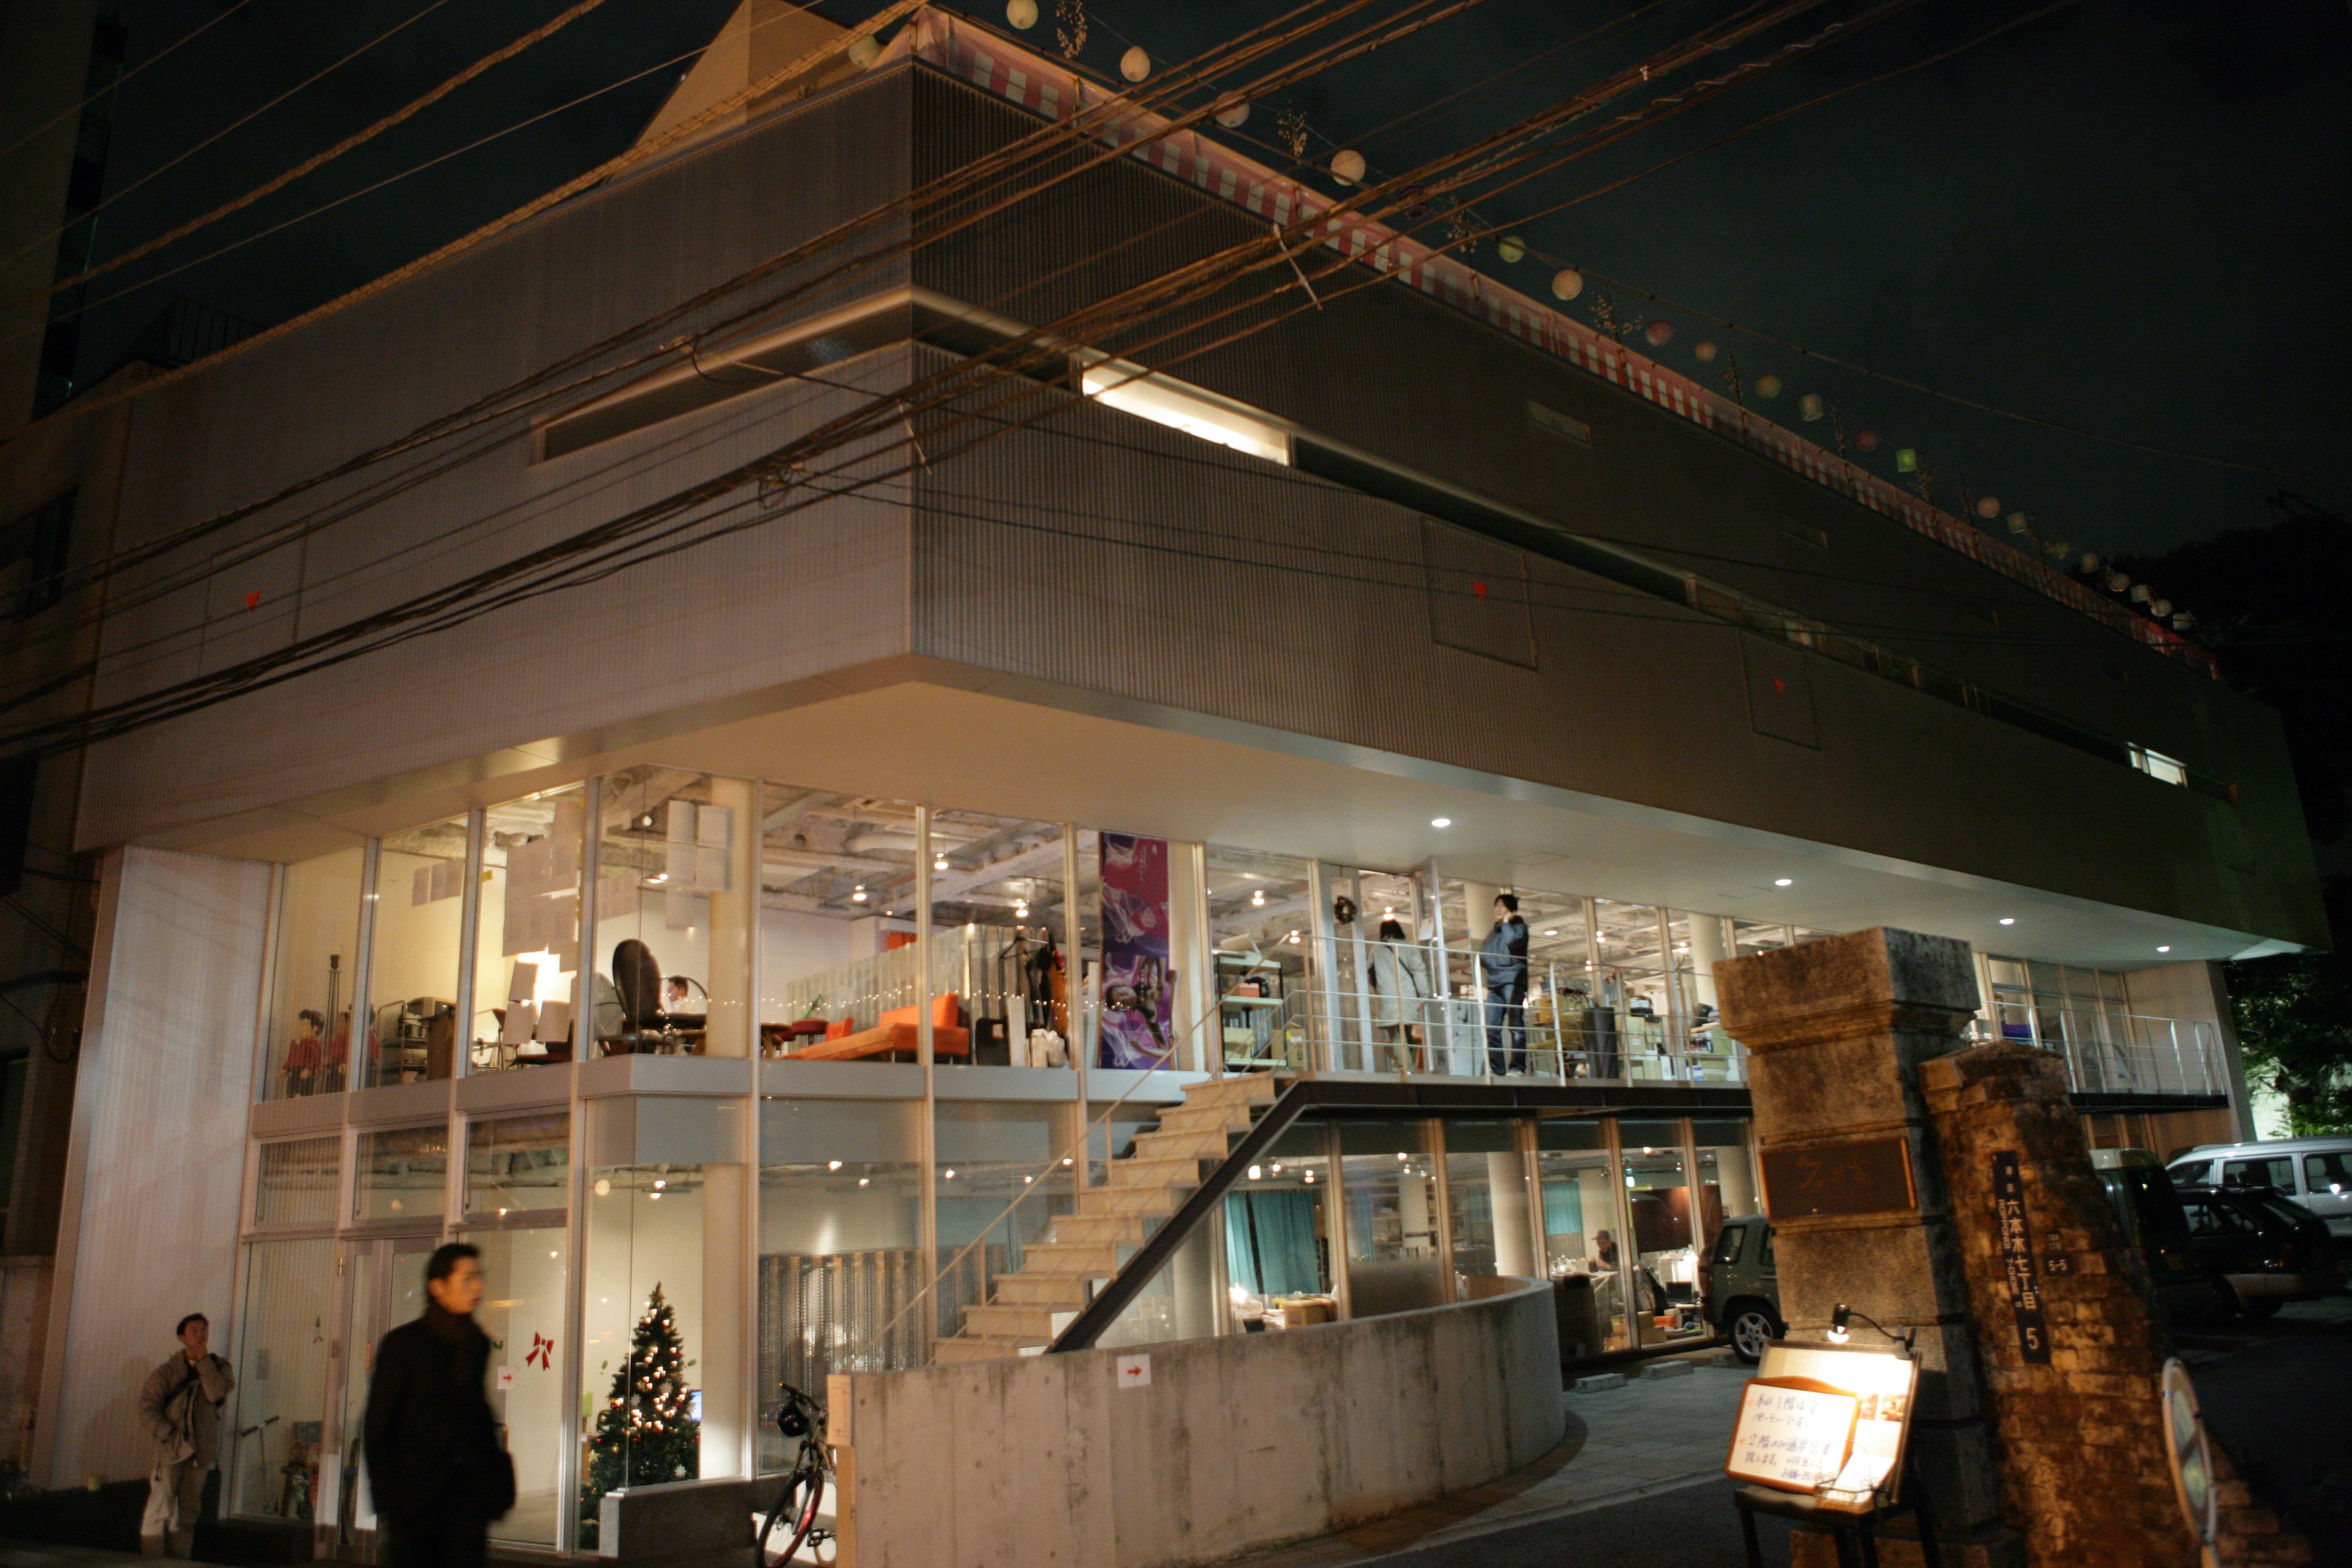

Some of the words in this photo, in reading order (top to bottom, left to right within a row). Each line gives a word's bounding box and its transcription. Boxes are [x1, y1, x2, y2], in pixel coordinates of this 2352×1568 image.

[2006, 1199, 2036, 1310] 六本木七丁目
[2025, 1327, 2039, 1350] 5
